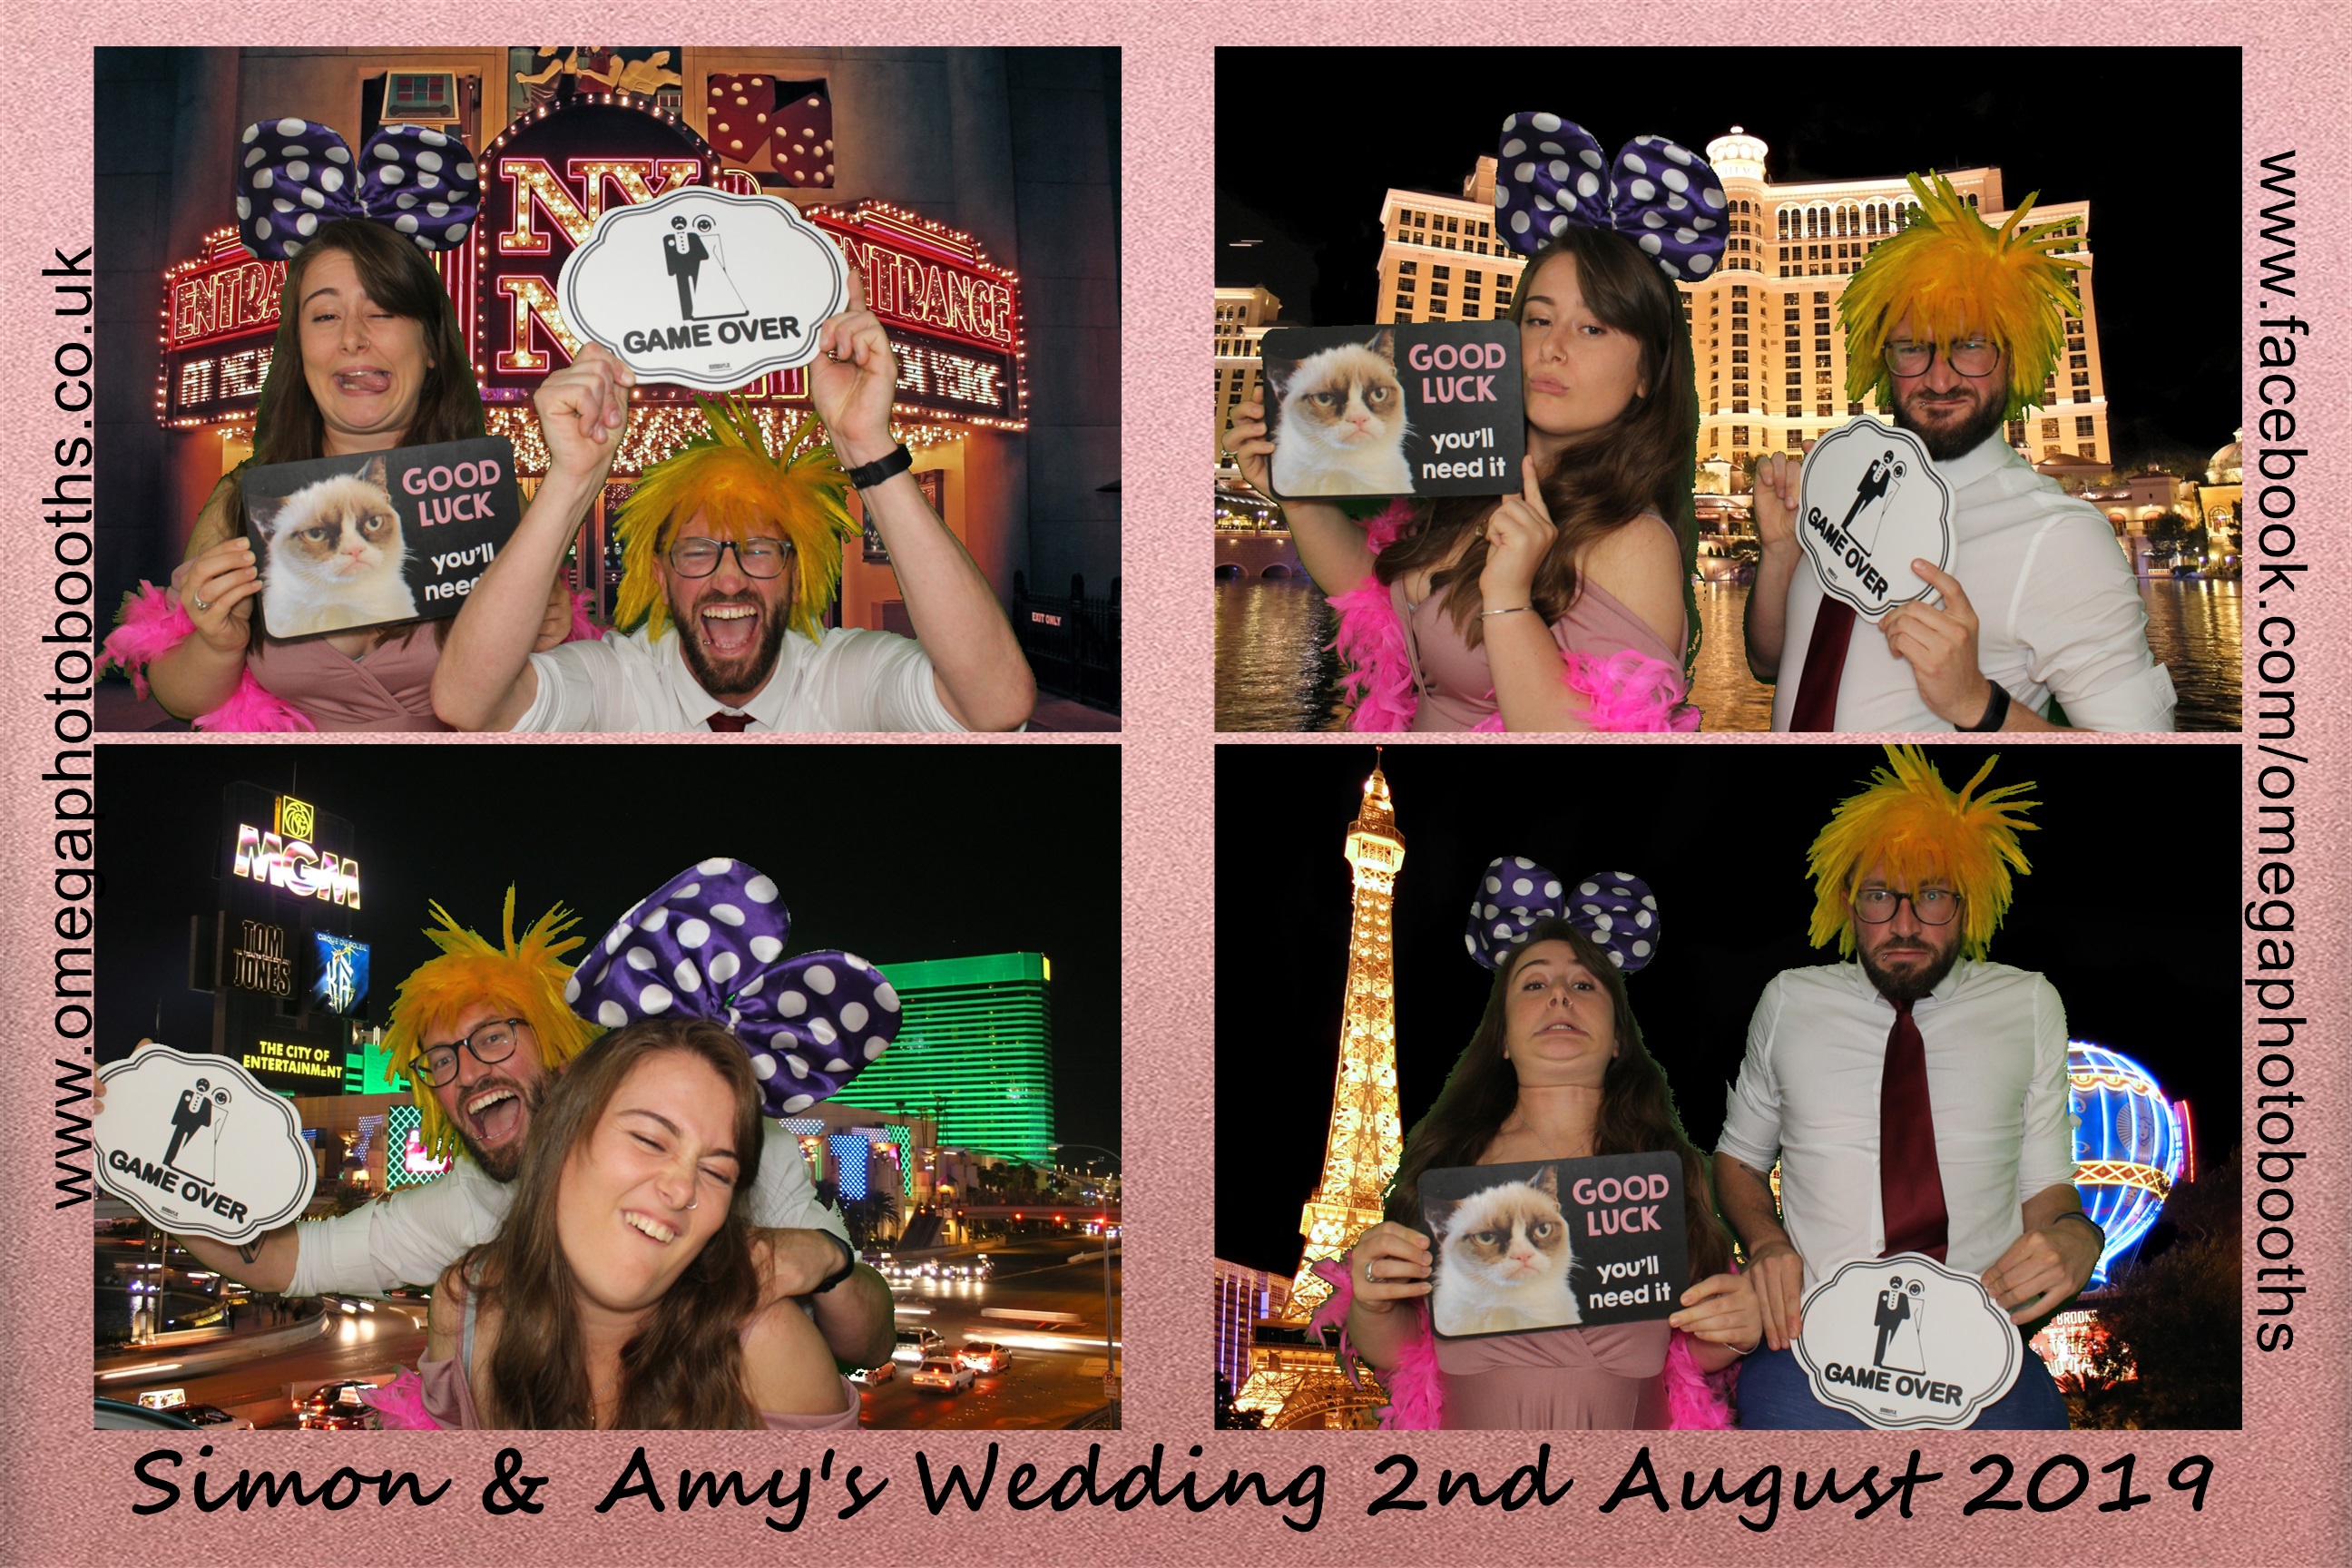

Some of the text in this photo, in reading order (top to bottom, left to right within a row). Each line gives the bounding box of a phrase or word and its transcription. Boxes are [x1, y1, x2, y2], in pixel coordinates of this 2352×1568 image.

[173, 260, 288, 339] ENTRA
[824, 229, 1012, 343] NTRANCE
[623, 316, 801, 354] GAME OVER
[1408, 343, 1506, 371] GOOD
[1422, 375, 1497, 404] LUCK
[1430, 427, 1494, 454] you'll
[402, 459, 501, 495] GOOD
[1422, 456, 1506, 479] need it
[417, 491, 495, 527] LUCK
[430, 543, 495, 575] you'll
[1808, 506, 1888, 602] GAME OVER
[233, 823, 361, 910] MGM
[242, 919, 284, 959] TOM
[233, 955, 291, 995] JONES
[242, 1054, 343, 1078] ENTERTAINMENT
[260, 1041, 330, 1063] THE CITY OF
[109, 1149, 248, 1224] GAME OVER
[1573, 1173, 1670, 1205] GOOD
[1587, 1205, 1661, 1237] LUCK
[1596, 1255, 1660, 1285] you'll
[1589, 1282, 1671, 1309] need it
[1825, 1362, 1964, 1406] GAME OVER
